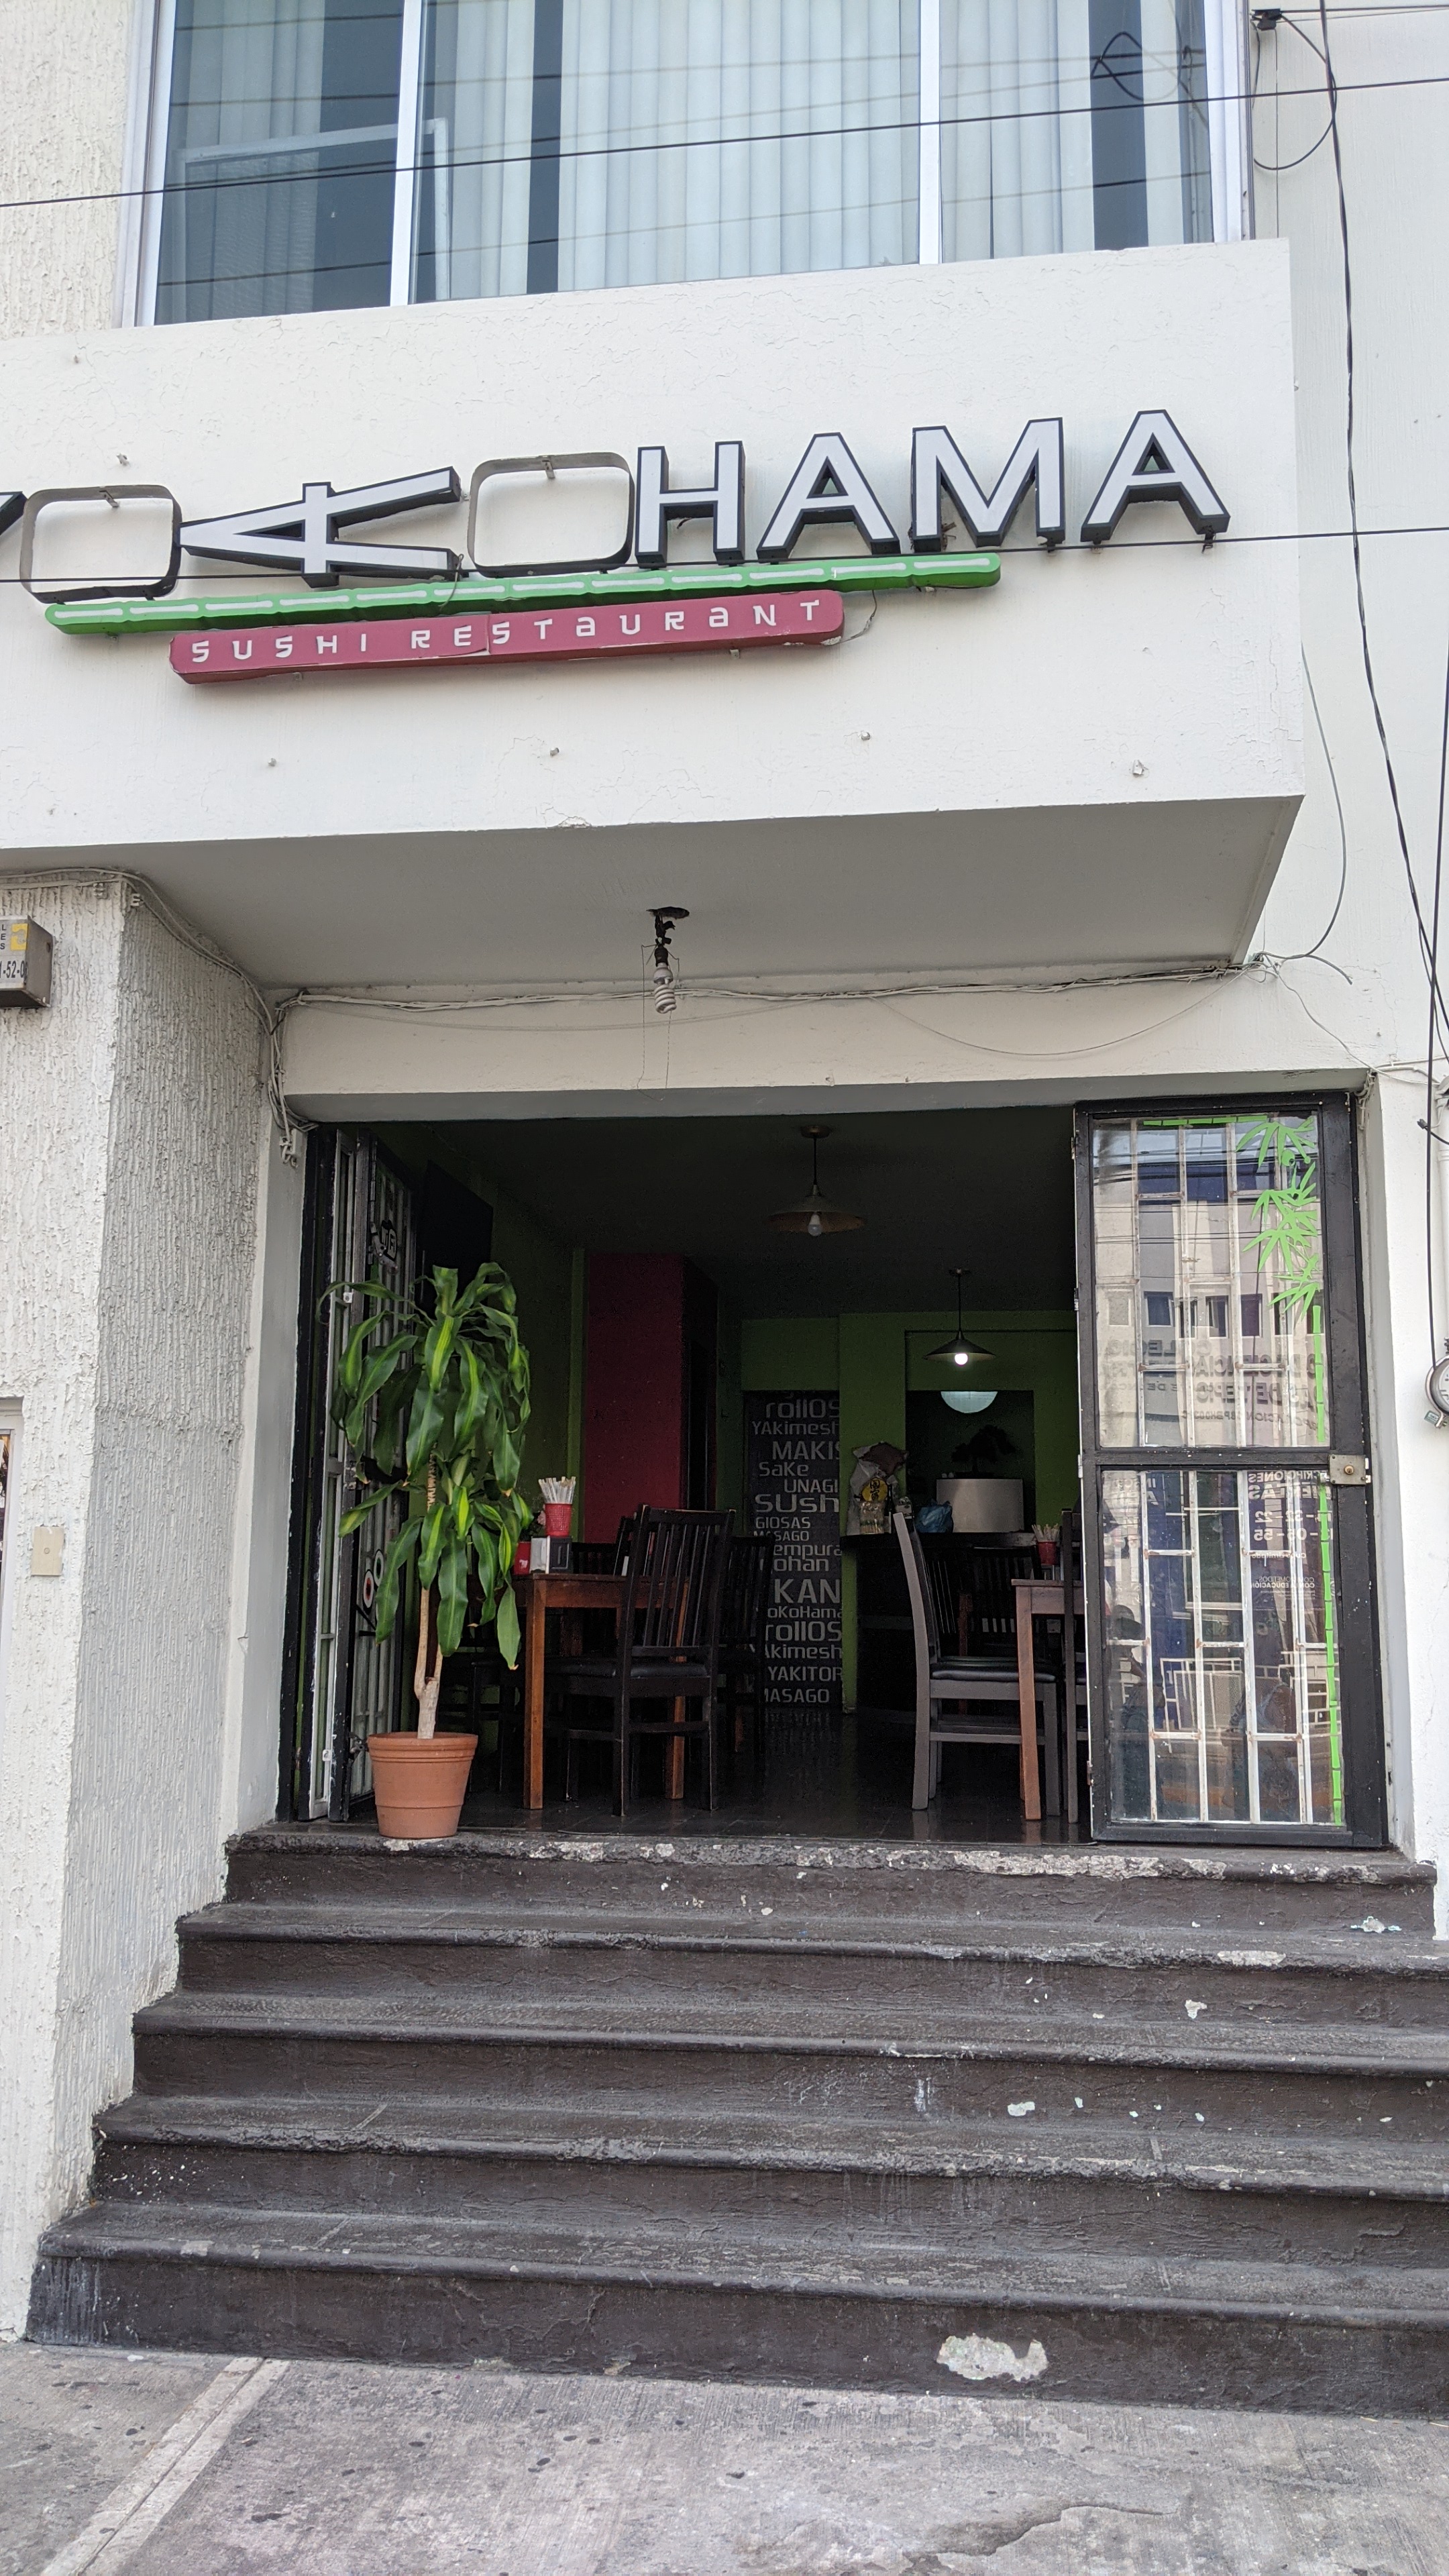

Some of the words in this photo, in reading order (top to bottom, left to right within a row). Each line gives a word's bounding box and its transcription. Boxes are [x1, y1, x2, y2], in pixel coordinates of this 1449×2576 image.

[0, 409, 1230, 604] OKOHAMA
[191, 633, 368, 663] SUSHI
[784, 1479, 839, 1493] UNAGI
[773, 1544, 842, 1560] empura
[773, 1556, 829, 1572] ohan
[767, 1605, 842, 1618] oKoHam
[765, 1644, 842, 1659] kimesh
